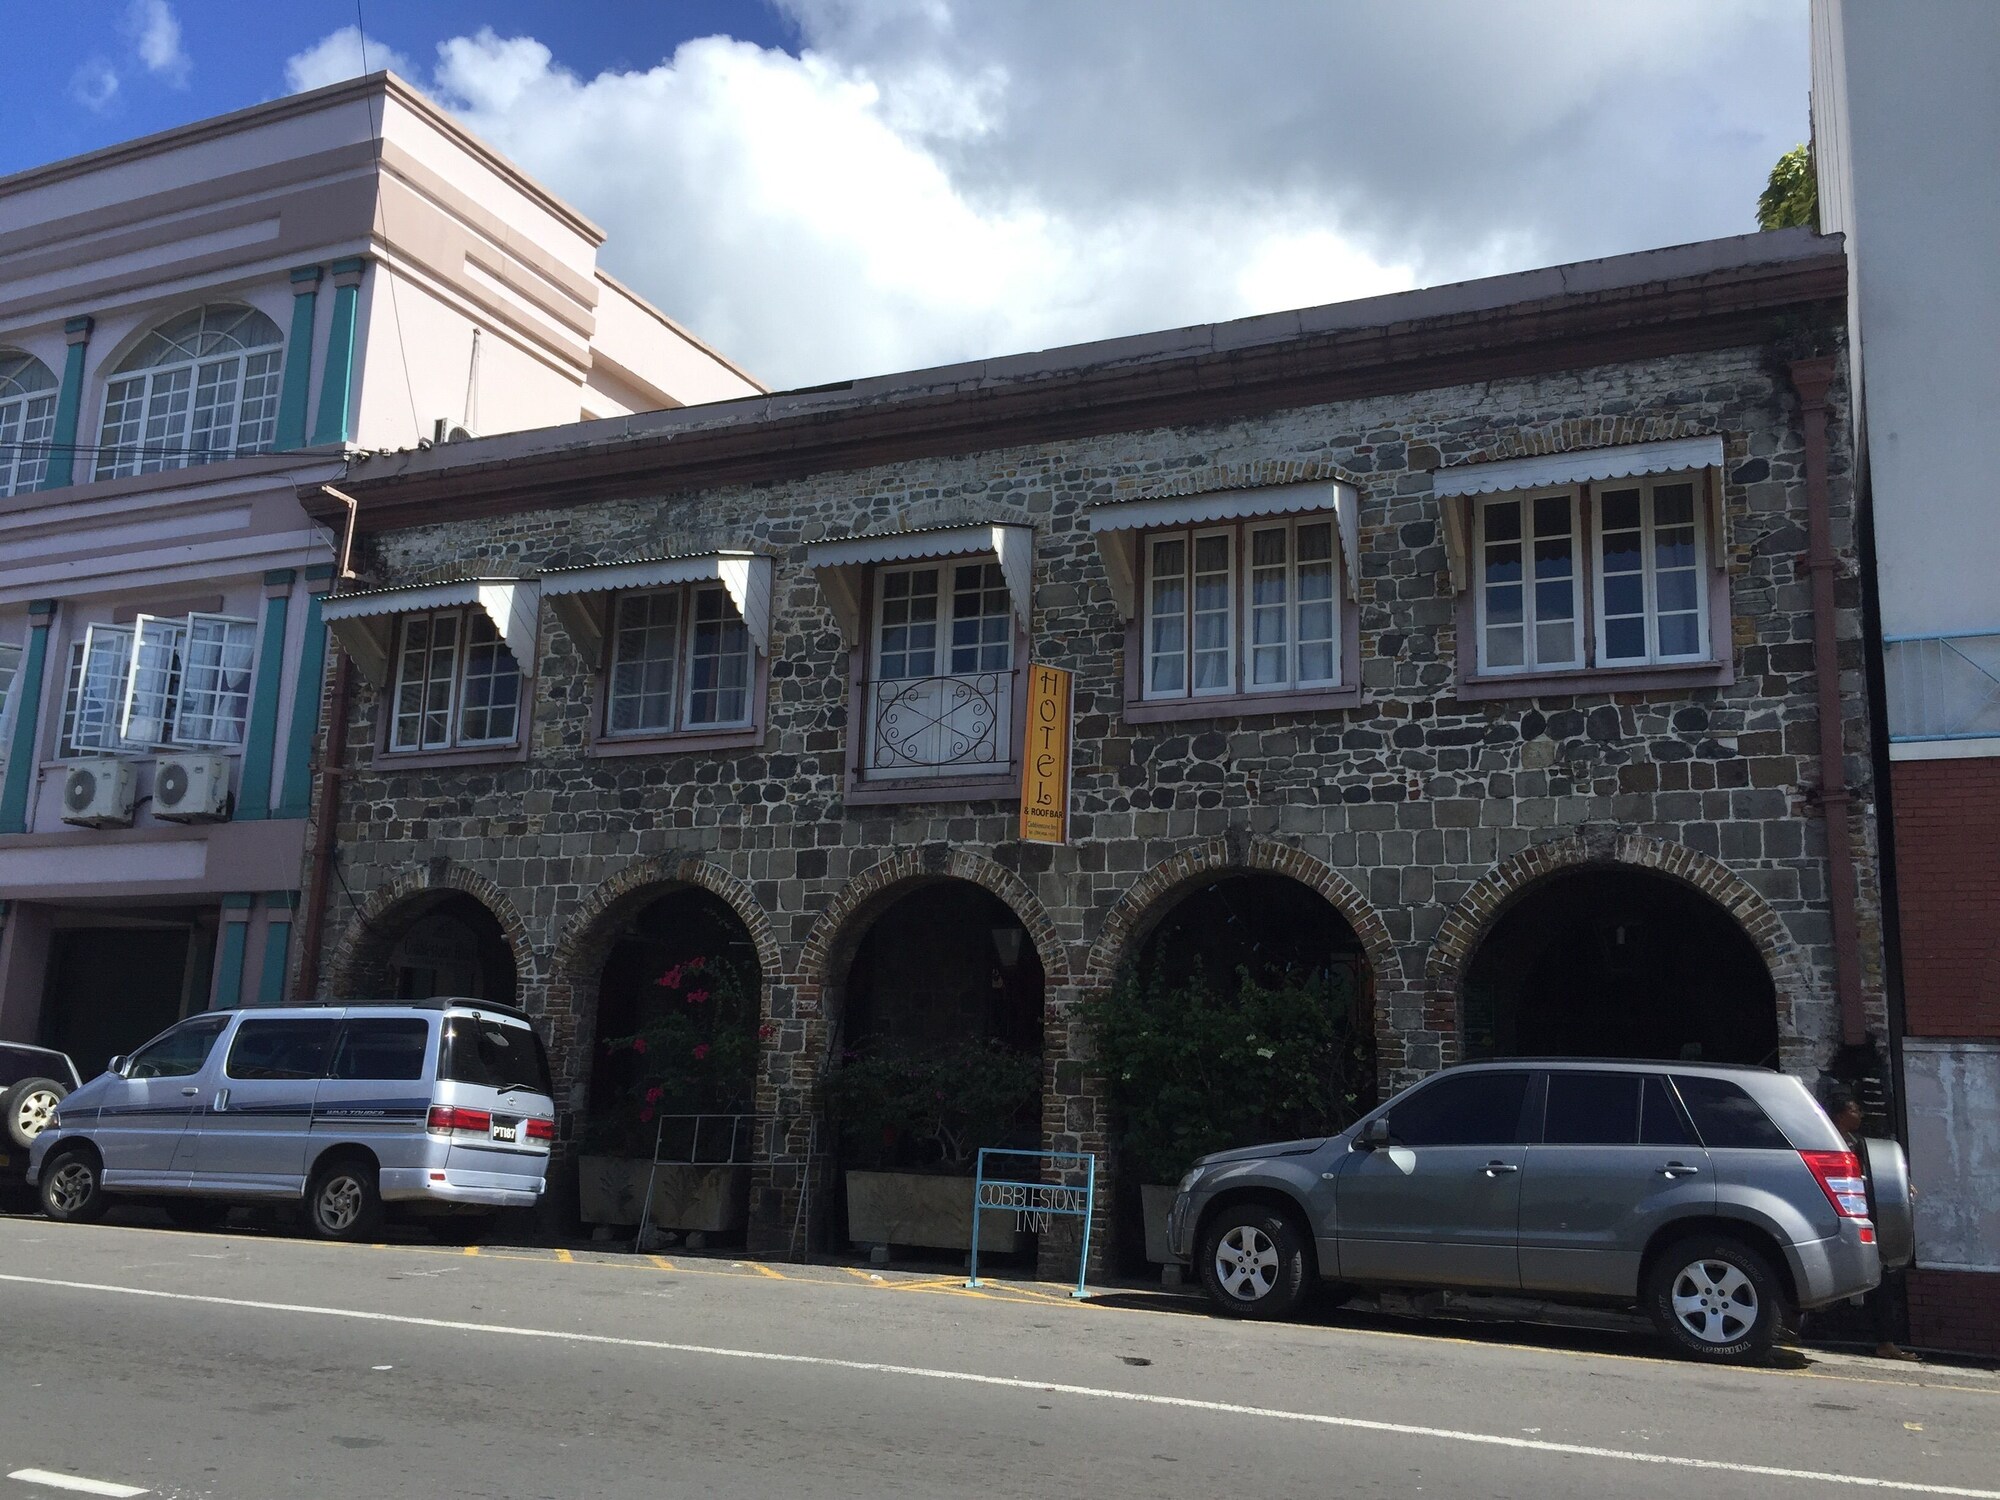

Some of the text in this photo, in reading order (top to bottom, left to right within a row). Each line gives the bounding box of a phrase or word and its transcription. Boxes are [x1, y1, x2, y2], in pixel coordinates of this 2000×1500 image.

[1036, 671, 1058, 806] HOTEL
[1023, 806, 1029, 815] &
[979, 1184, 1085, 1212] COBBLESTONE
[1014, 1209, 1049, 1234] INN
